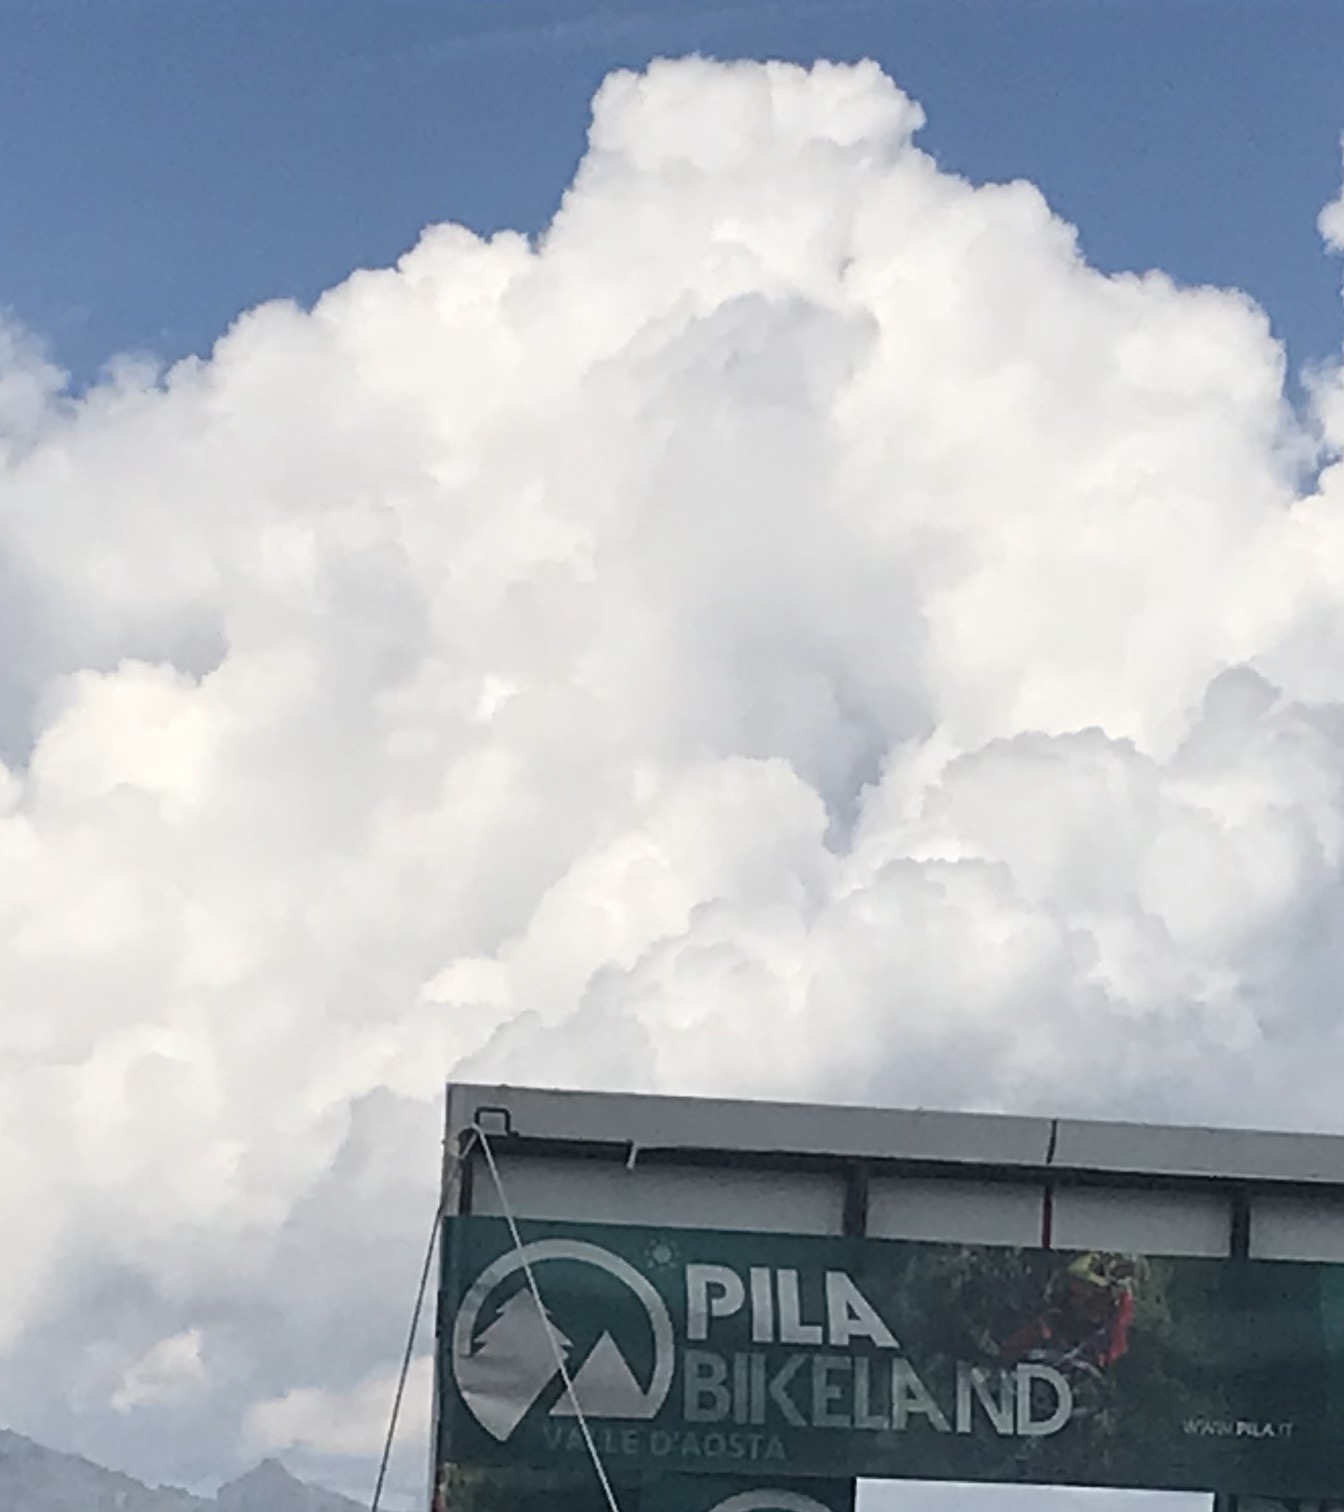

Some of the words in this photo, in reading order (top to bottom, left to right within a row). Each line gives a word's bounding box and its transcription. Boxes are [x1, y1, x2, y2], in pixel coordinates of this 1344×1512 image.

[686, 1263, 900, 1348] PILA
[682, 1351, 1073, 1438] BIKELAND
[543, 1425, 639, 1455] VALLE
[649, 1428, 787, 1462] D'AOSTA
[1182, 1419, 1295, 1439] WWW.PILA.IT
